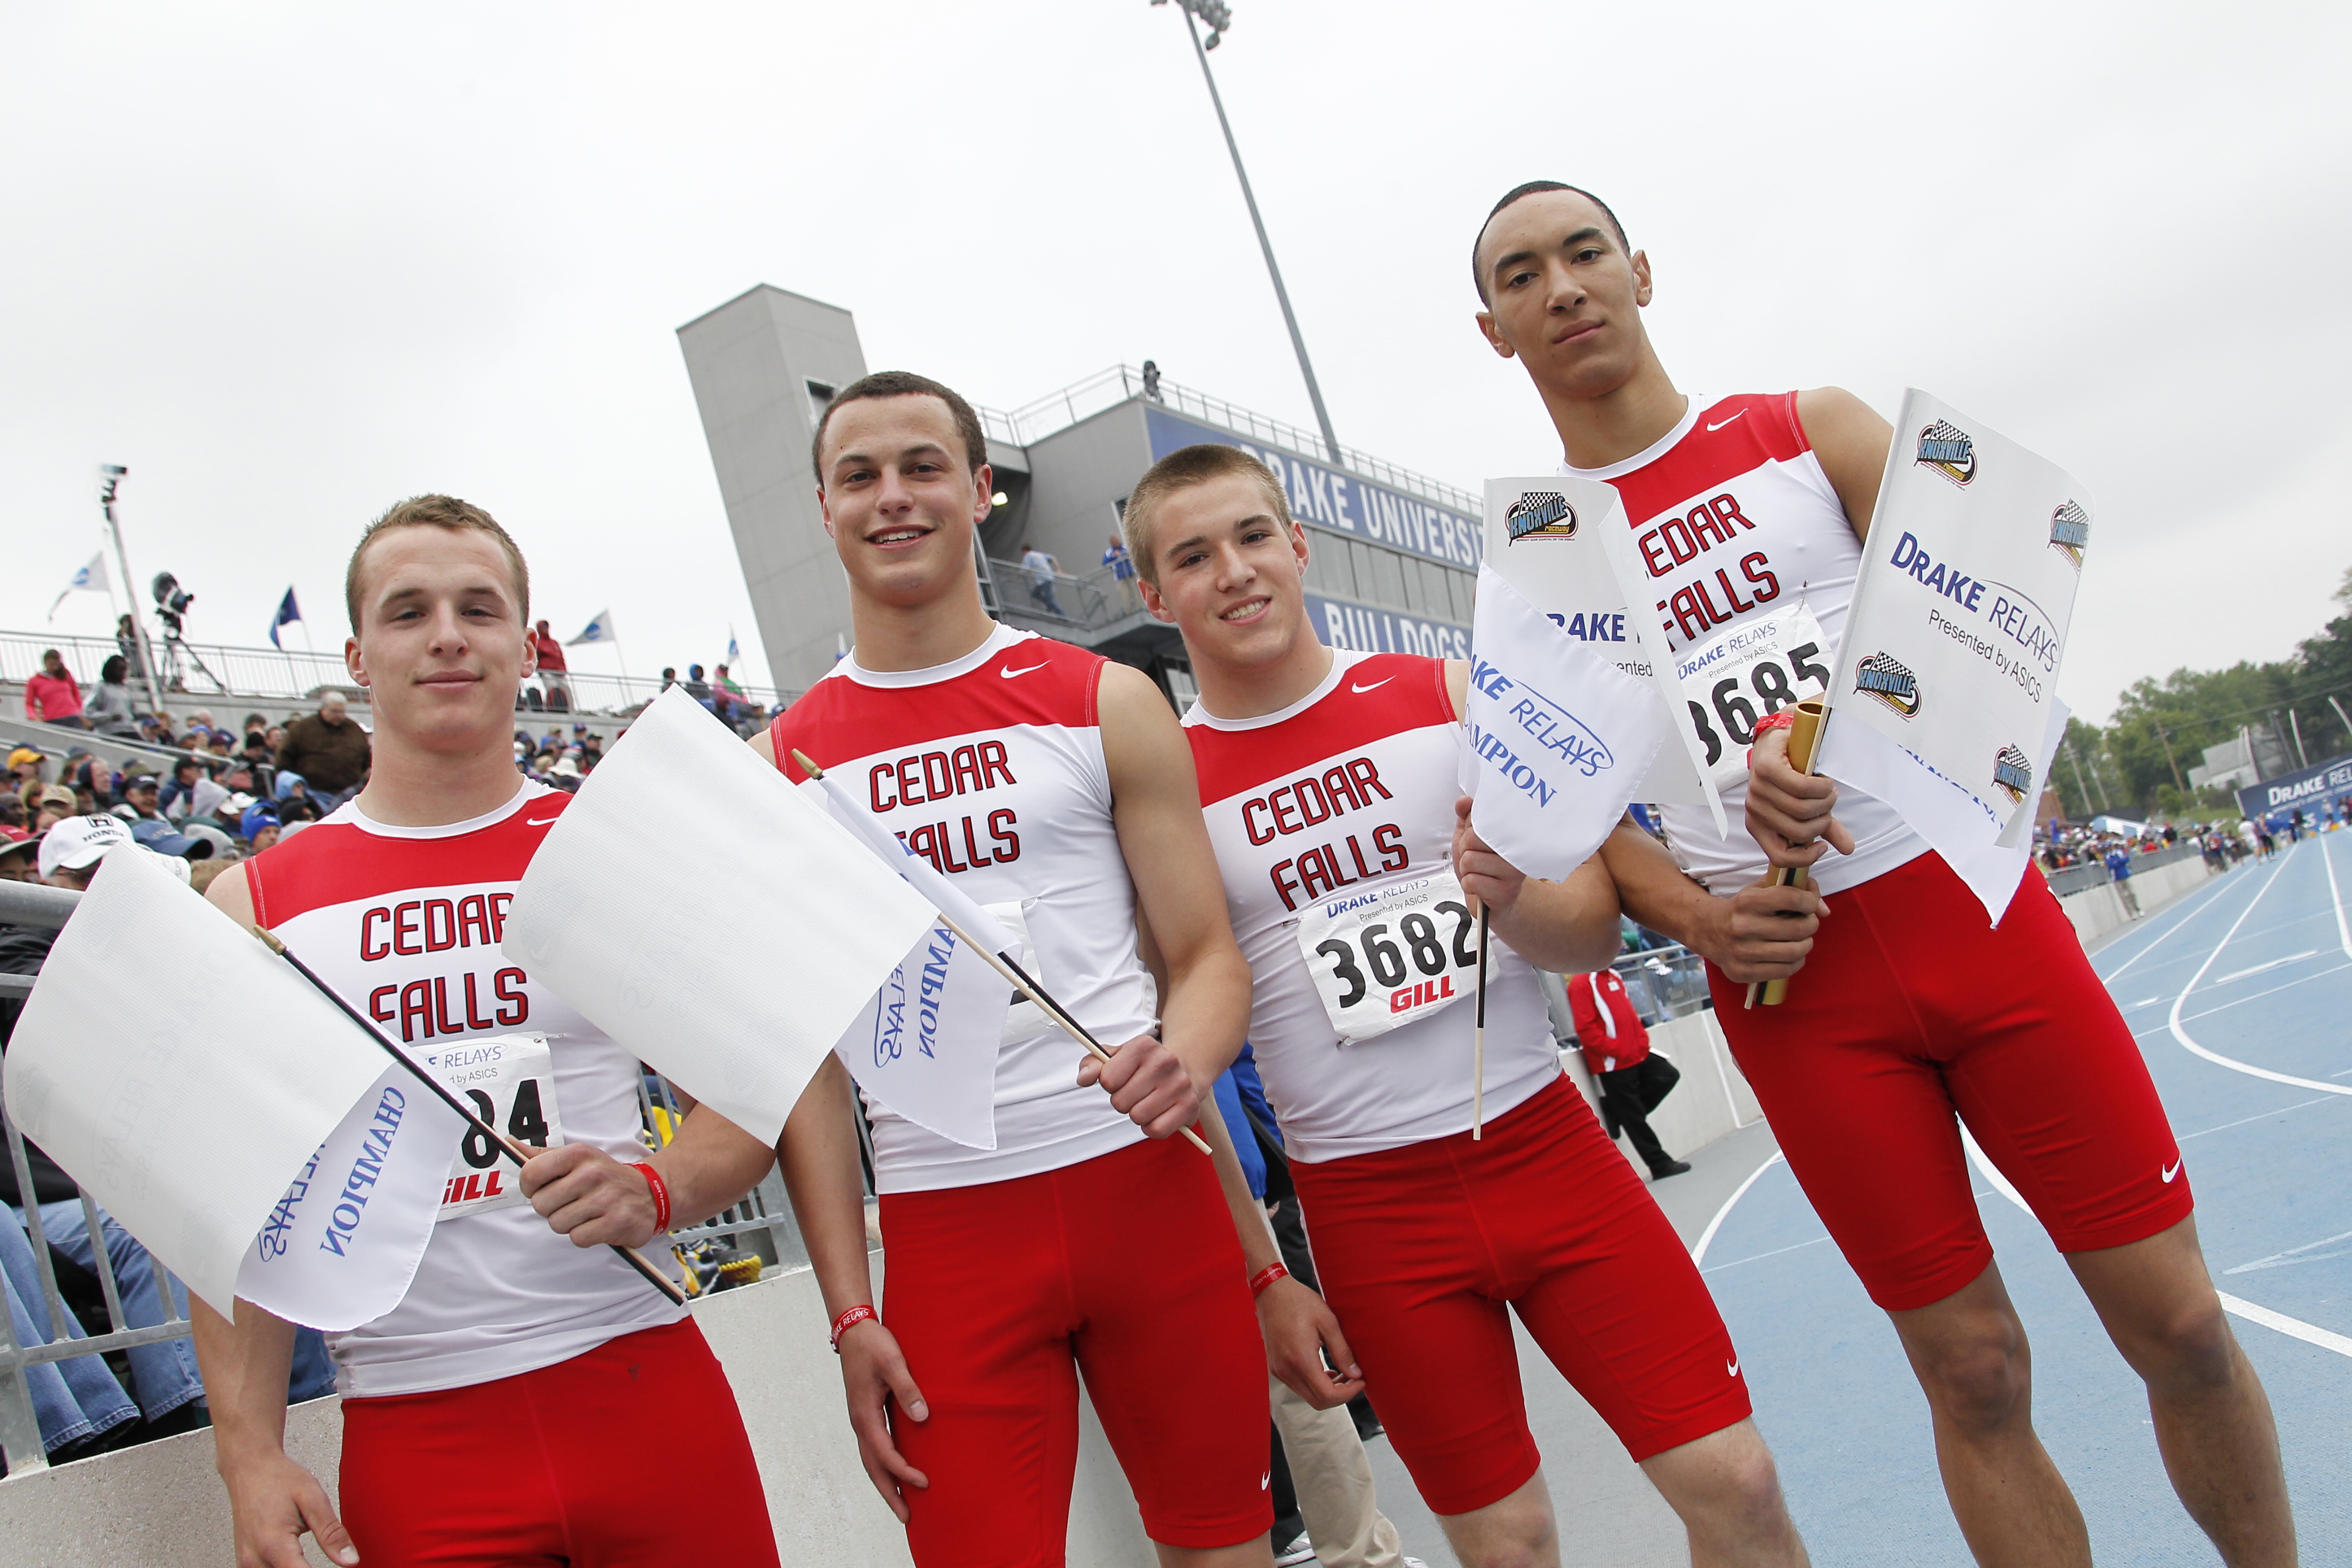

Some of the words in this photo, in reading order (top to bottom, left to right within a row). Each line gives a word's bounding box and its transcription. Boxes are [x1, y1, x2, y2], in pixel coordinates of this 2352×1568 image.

[1918, 439, 1971, 462] KNOXVILLE
[1509, 497, 1566, 538] KNOXVILLE
[1638, 493, 1757, 578] EDAR
[1890, 531, 1987, 613] DRAKE
[1988, 596, 2058, 672] RELAYS
[1546, 613, 1626, 642] AKE
[1611, 661, 1653, 677] ented
[1677, 645, 1725, 681] DRAKE
[1729, 622, 1777, 653] RELAYS
[1708, 658, 1743, 678] Presented
[1743, 653, 1754, 662] by
[1753, 641, 1778, 658] ASICS
[1928, 608, 1994, 660] Presented
[1995, 648, 2011, 675] by
[2010, 661, 2042, 703] ASICS
[1857, 669, 1915, 695] KNOXVILLE
[1509, 698, 1606, 777] RELAYS
[869, 740, 1018, 813] CEDAR
[2268, 775, 2325, 807] DRAKE
[1242, 757, 1394, 846] CEDAR
[83, 829, 124, 842] HONDA
[893, 808, 1020, 875] ALLS
[1270, 823, 1409, 912] FALLS
[1327, 893, 1378, 918] DRAKE
[1383, 879, 1429, 899] RELAYS
[1359, 905, 1395, 922] Presented
[1394, 902, 1404, 913] by
[1404, 893, 1429, 908] ASICS
[1315, 901, 1478, 1008] 3682
[370, 967, 529, 1042] FALLS
[1391, 975, 1455, 1013] GILL
[444, 1045, 502, 1069] RELAYS
[456, 1072, 467, 1083] by
[469, 1068, 498, 1081] ASICS
[843, 1309, 869, 1326] RELAYS
